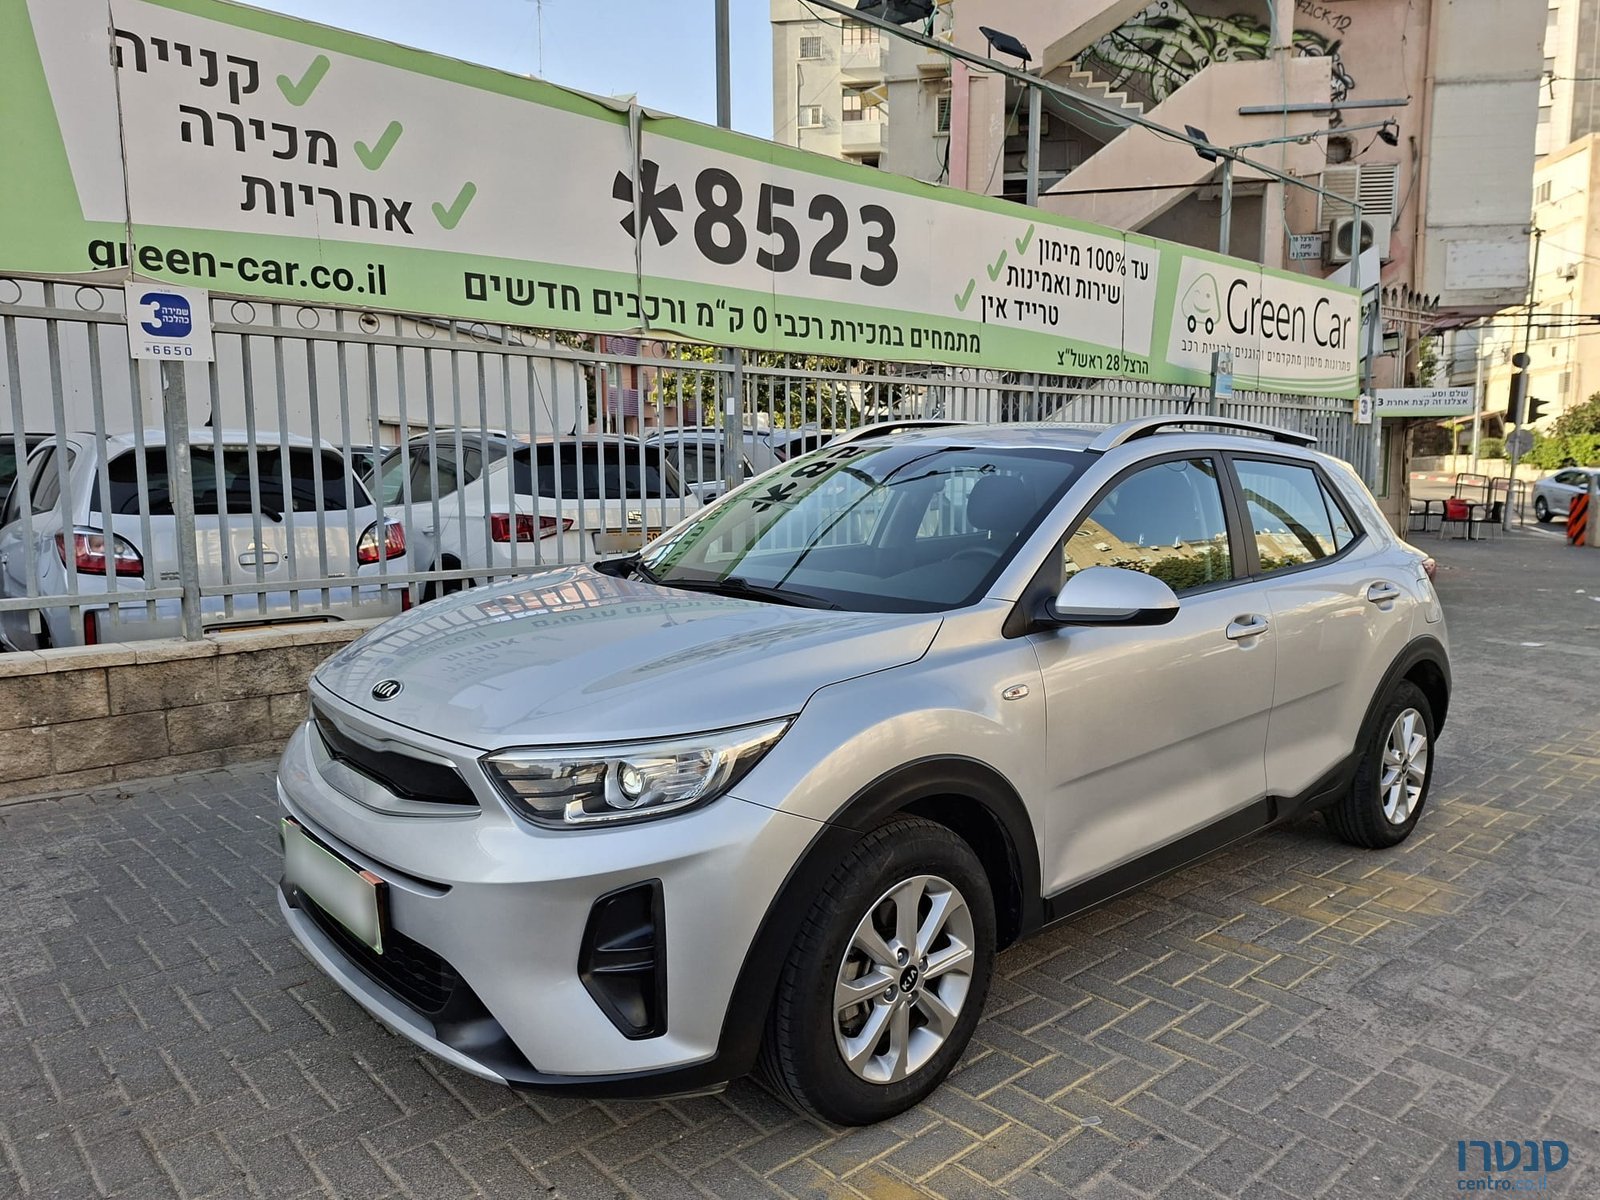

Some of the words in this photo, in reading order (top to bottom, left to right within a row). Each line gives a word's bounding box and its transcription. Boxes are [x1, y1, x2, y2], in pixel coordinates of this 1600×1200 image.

[108, 27, 259, 105] קנייה
[179, 104, 338, 168] מכירה
[240, 175, 414, 235] אחריות
[1038, 238, 1080, 266] מימון
[1086, 246, 1127, 276] 100%
[88, 239, 387, 296] green-car.co.il
[1006, 265, 1070, 296] ואמינות
[1131, 259, 1149, 280] עד
[464, 271, 581, 312] חדשים
[1075, 278, 1120, 304] שירות
[161, 307, 189, 316] שמירה
[162, 315, 190, 324] כהלכה
[593, 288, 686, 324] ורכבים
[753, 305, 767, 334] 0
[981, 294, 1008, 324] אין
[1013, 300, 1059, 325] טרייד
[1227, 278, 1306, 343] Green
[1313, 297, 1352, 350] Car
[775, 313, 823, 340] רכבי
[830, 318, 904, 347] במכירת
[910, 327, 981, 353] מתמחים
[1181, 339, 1199, 352] רכב
[1106, 353, 1120, 371] 28
[1123, 354, 1149, 375] הרצל
